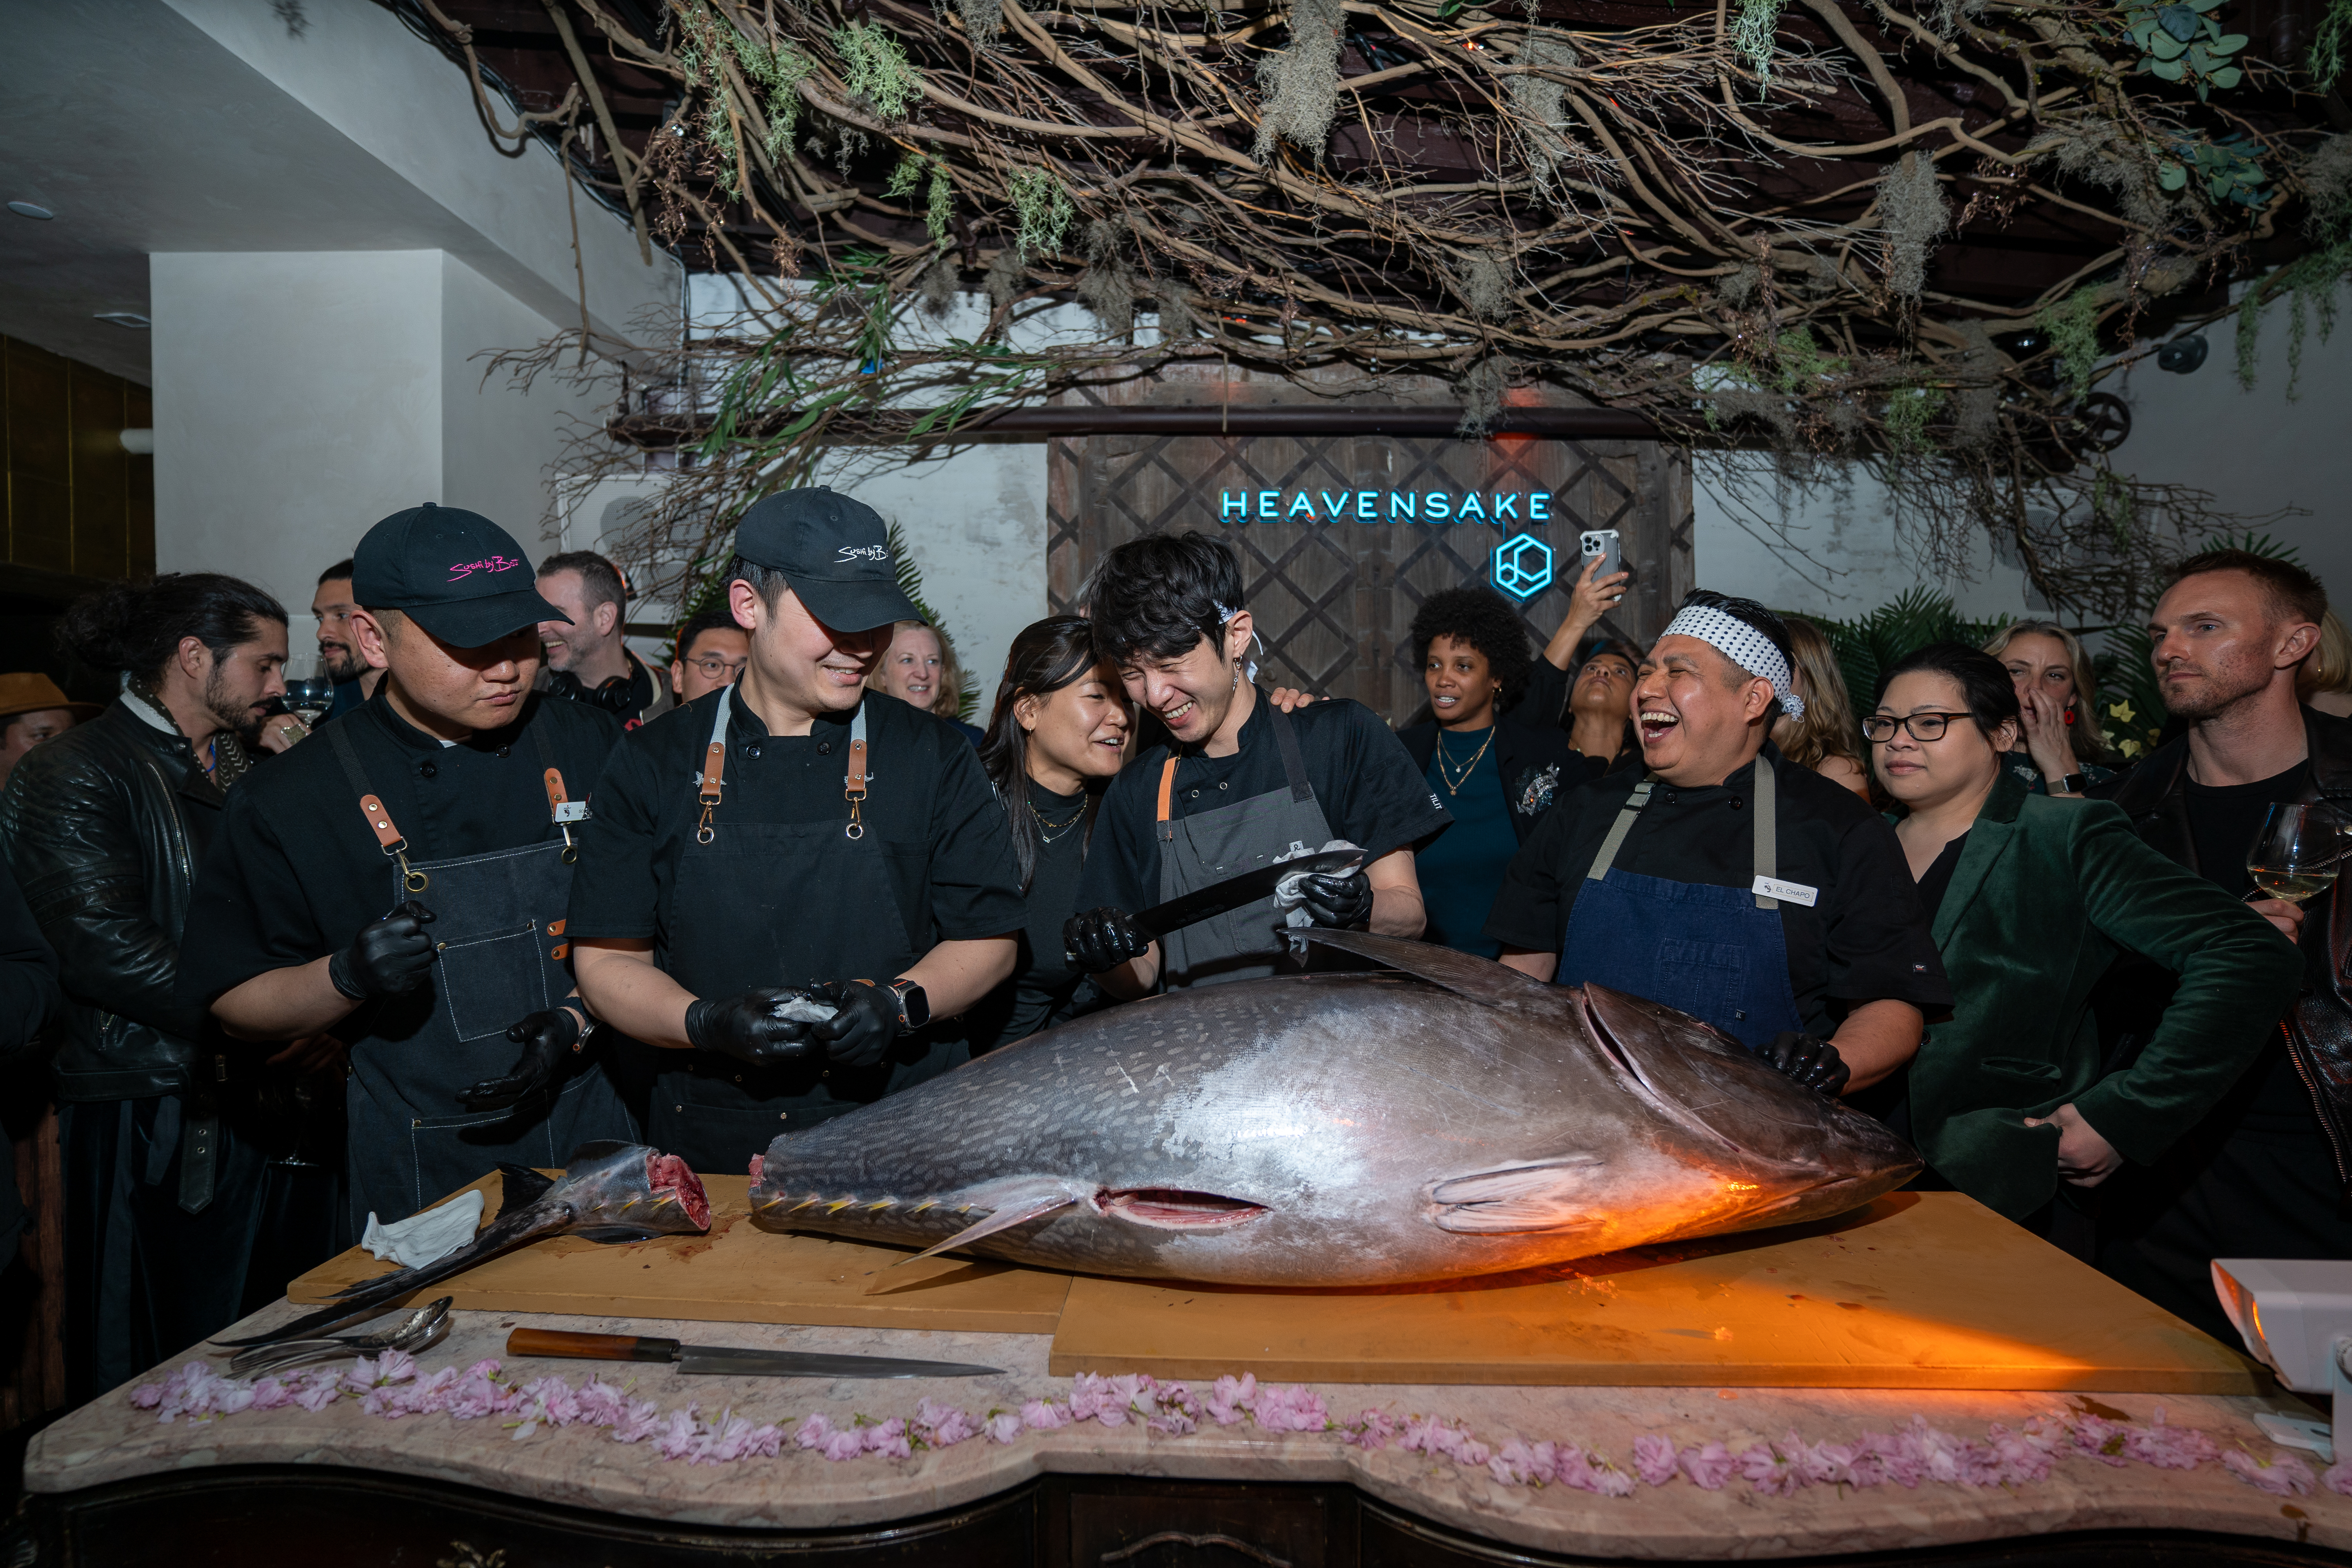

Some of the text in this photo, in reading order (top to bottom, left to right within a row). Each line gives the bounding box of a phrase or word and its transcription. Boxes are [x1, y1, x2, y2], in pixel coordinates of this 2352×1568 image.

[1223, 491, 1550, 519] HEAVENSAKE
[867, 547, 875, 561] by
[485, 559, 494, 573] by
[1430, 793, 1442, 809] TILIT
[1786, 889, 1810, 898] CHAPO
